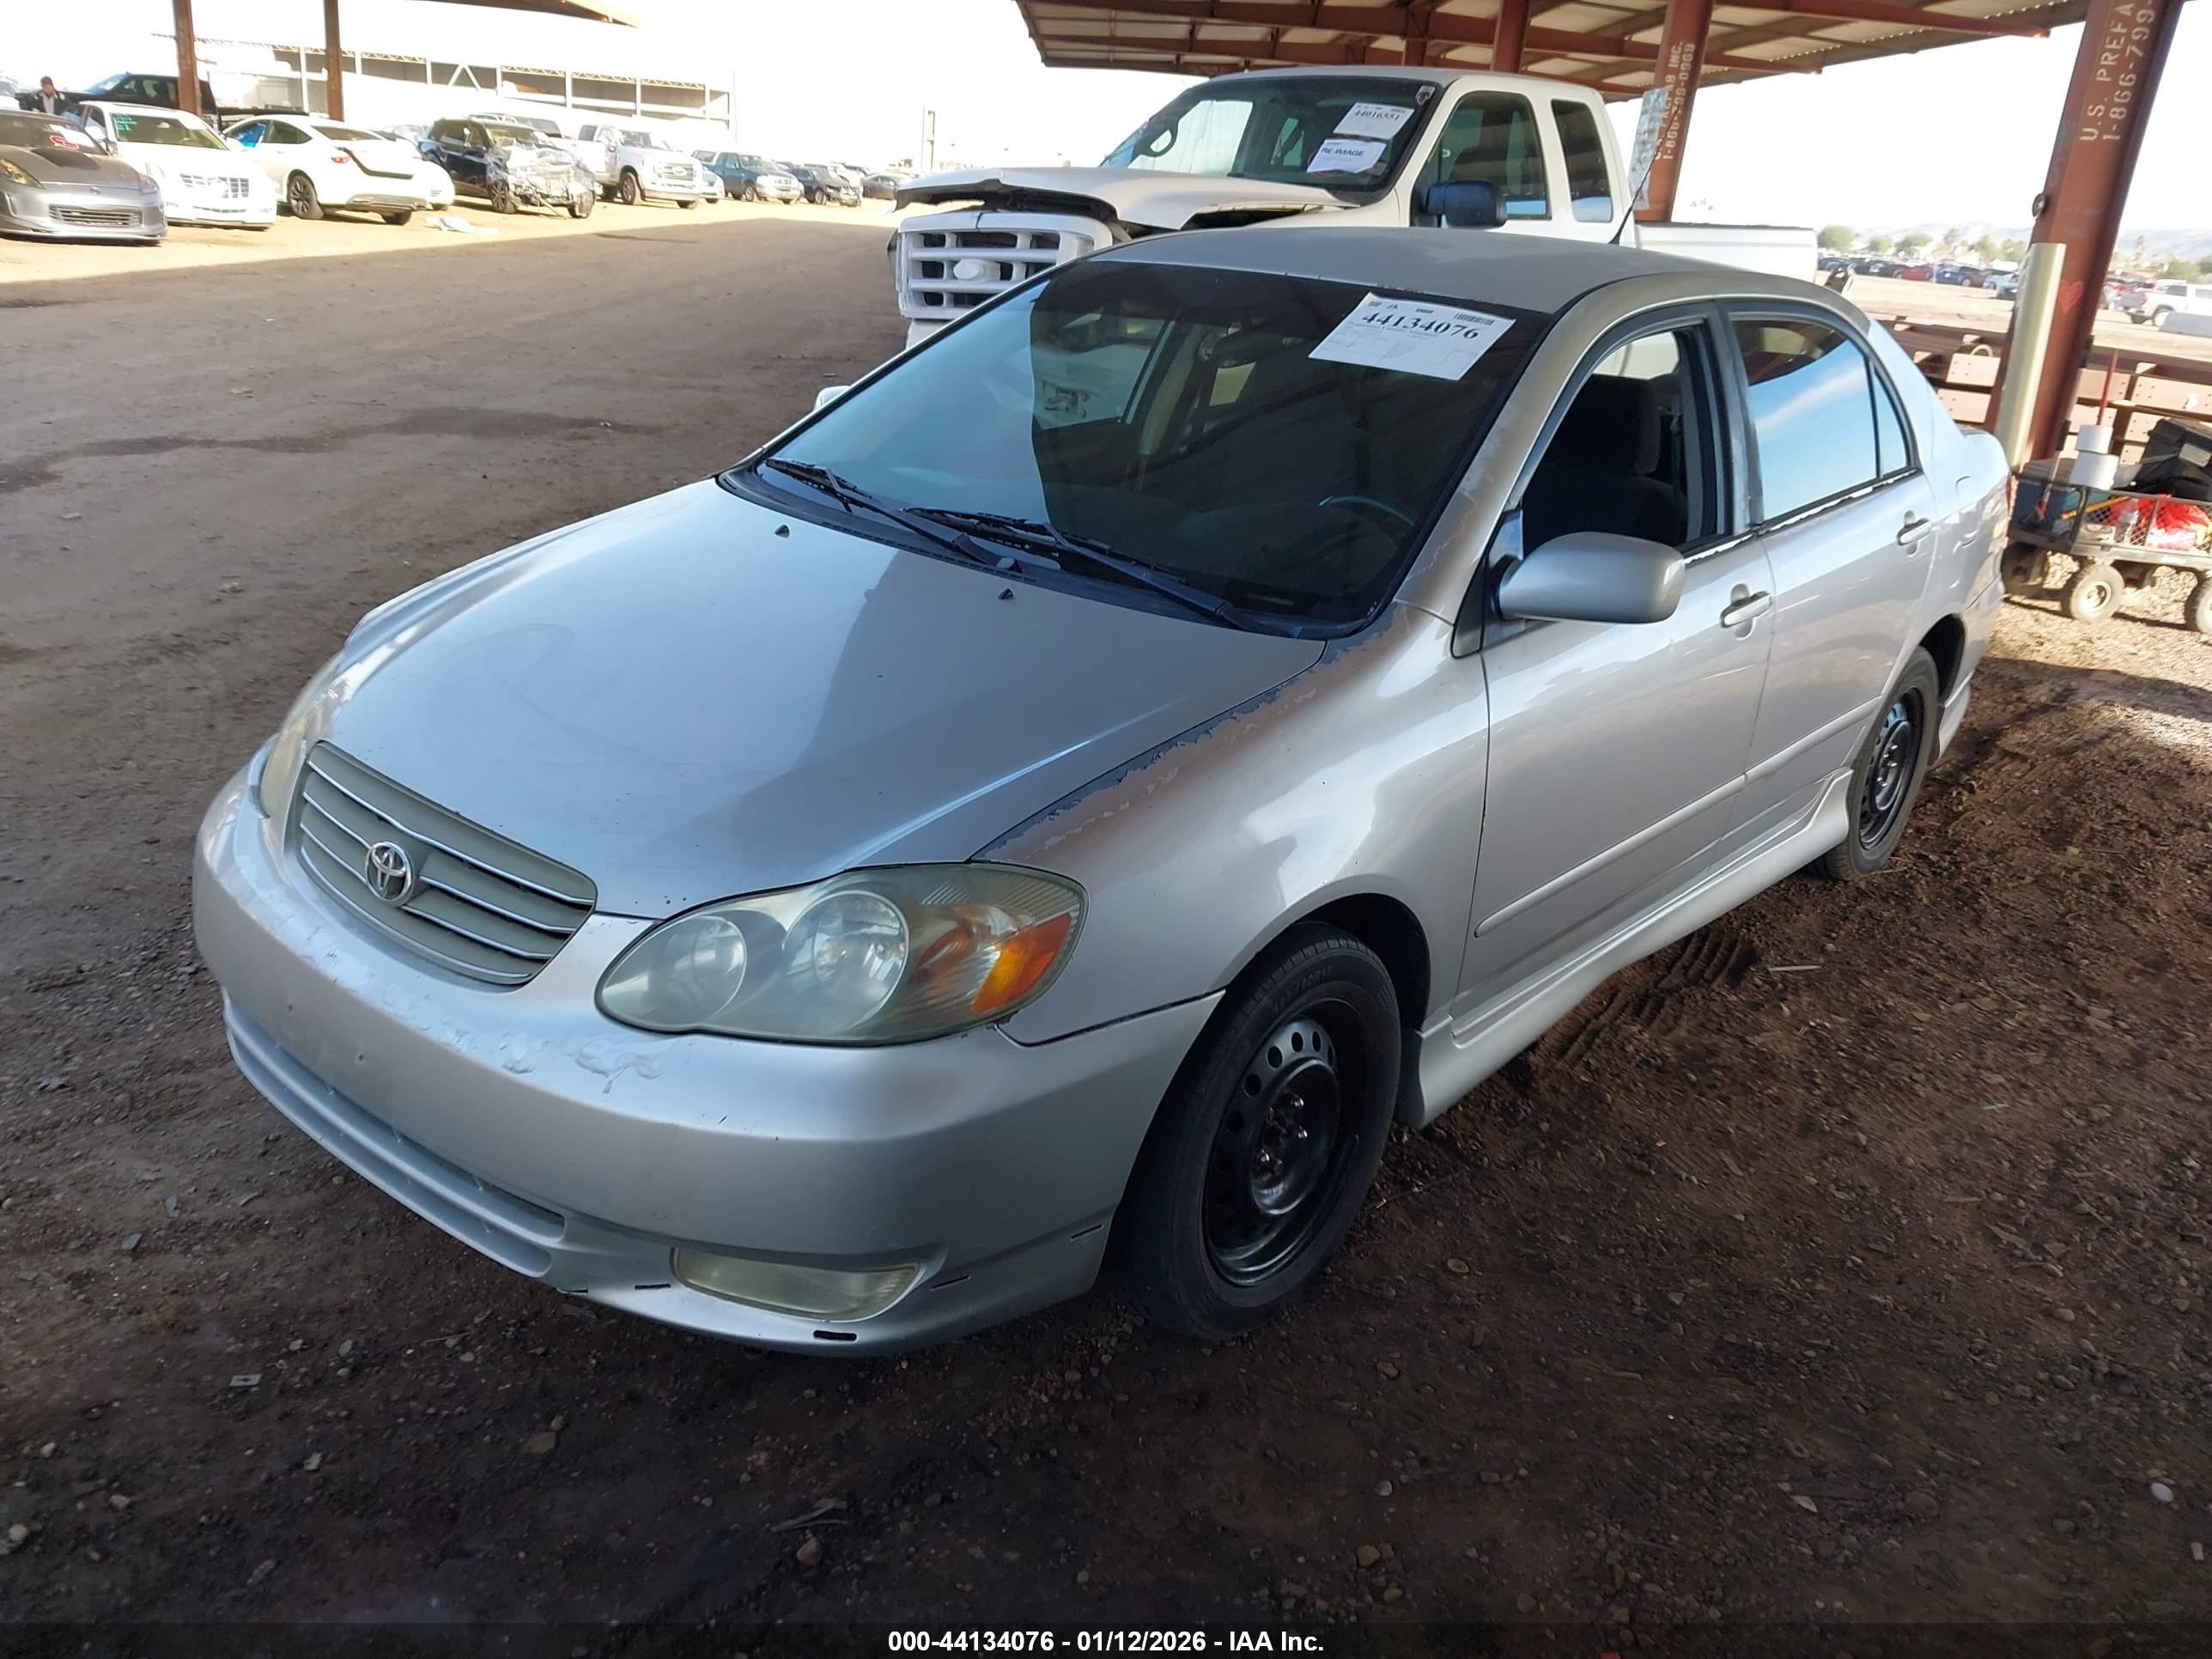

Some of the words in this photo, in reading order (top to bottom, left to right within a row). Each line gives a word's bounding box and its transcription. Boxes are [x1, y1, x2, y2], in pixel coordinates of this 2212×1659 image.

[1668, 42, 1683, 68] INC.
[2080, 97, 2108, 142] U.S.
[1361, 312, 1480, 340] 44134076
